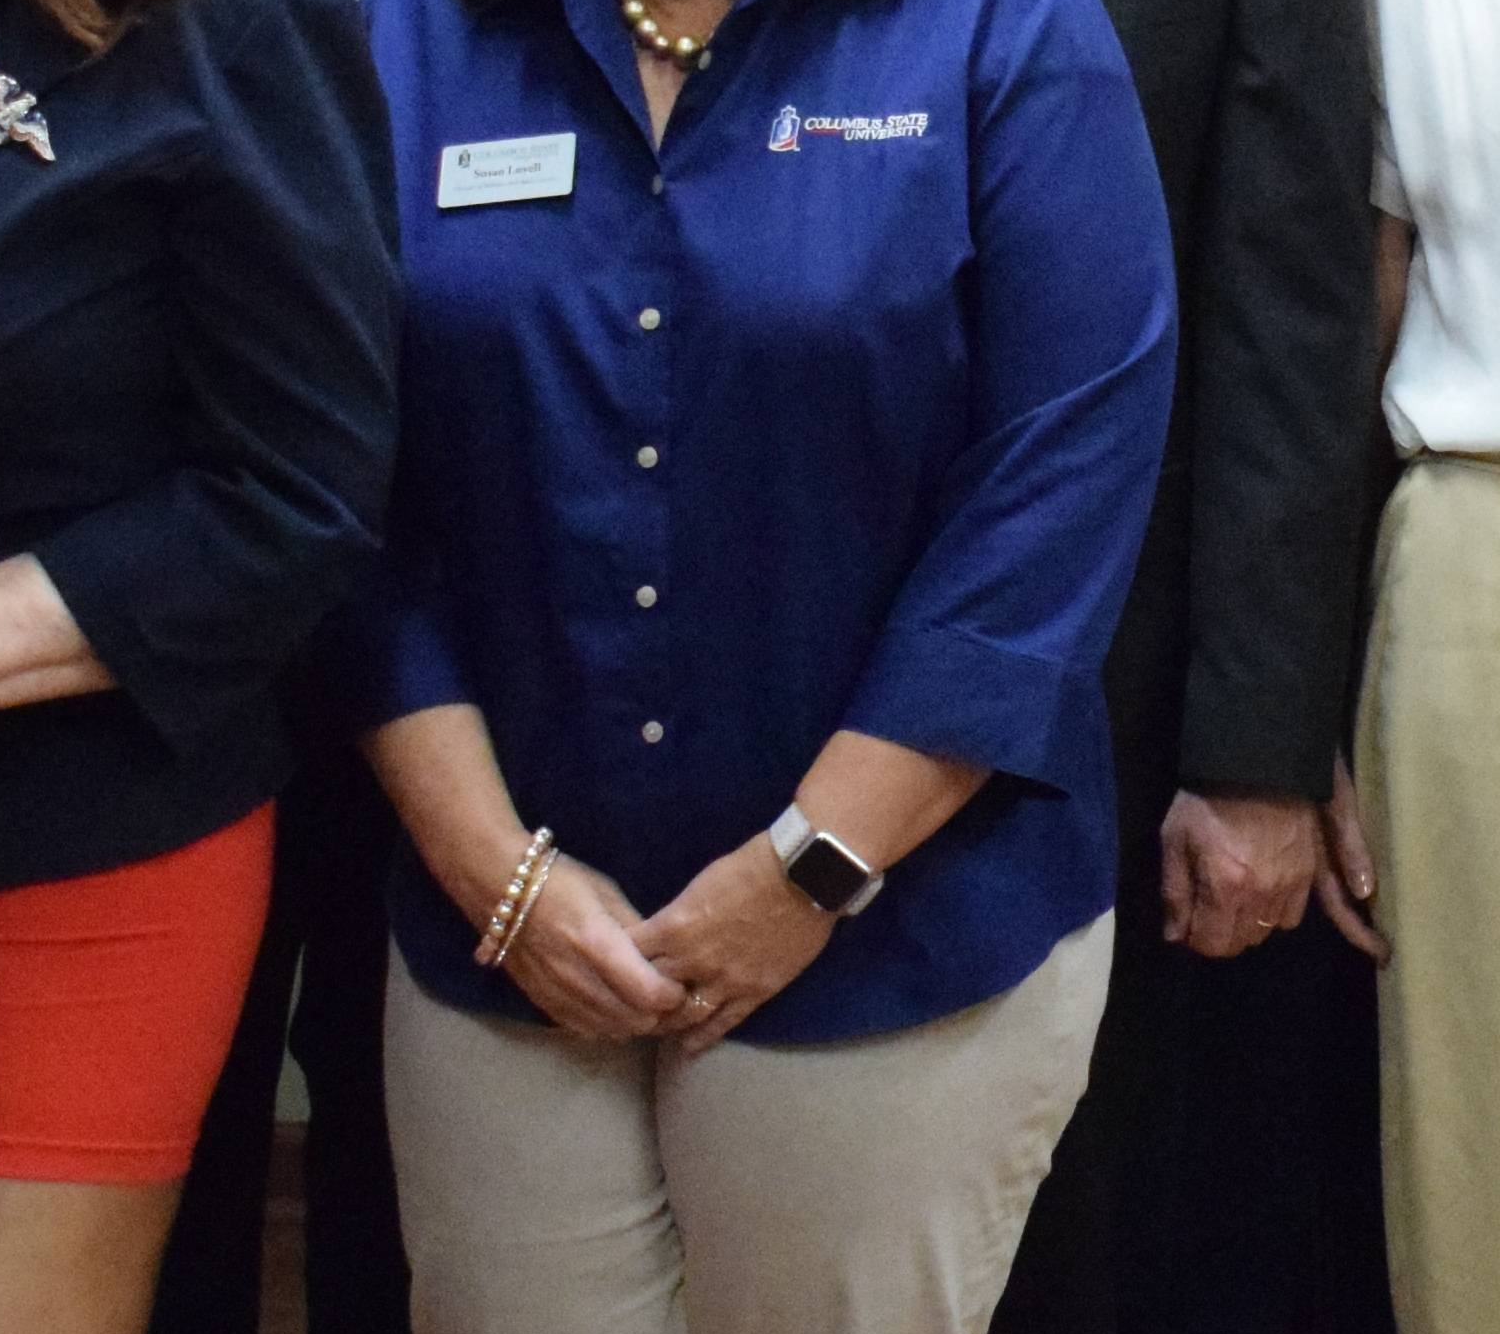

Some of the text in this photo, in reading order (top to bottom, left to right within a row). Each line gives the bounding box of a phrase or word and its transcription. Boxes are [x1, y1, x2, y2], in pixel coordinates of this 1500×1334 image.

[804, 113, 929, 131] COLUMBUS STATE
[844, 125, 926, 141] UNIVERSITY
